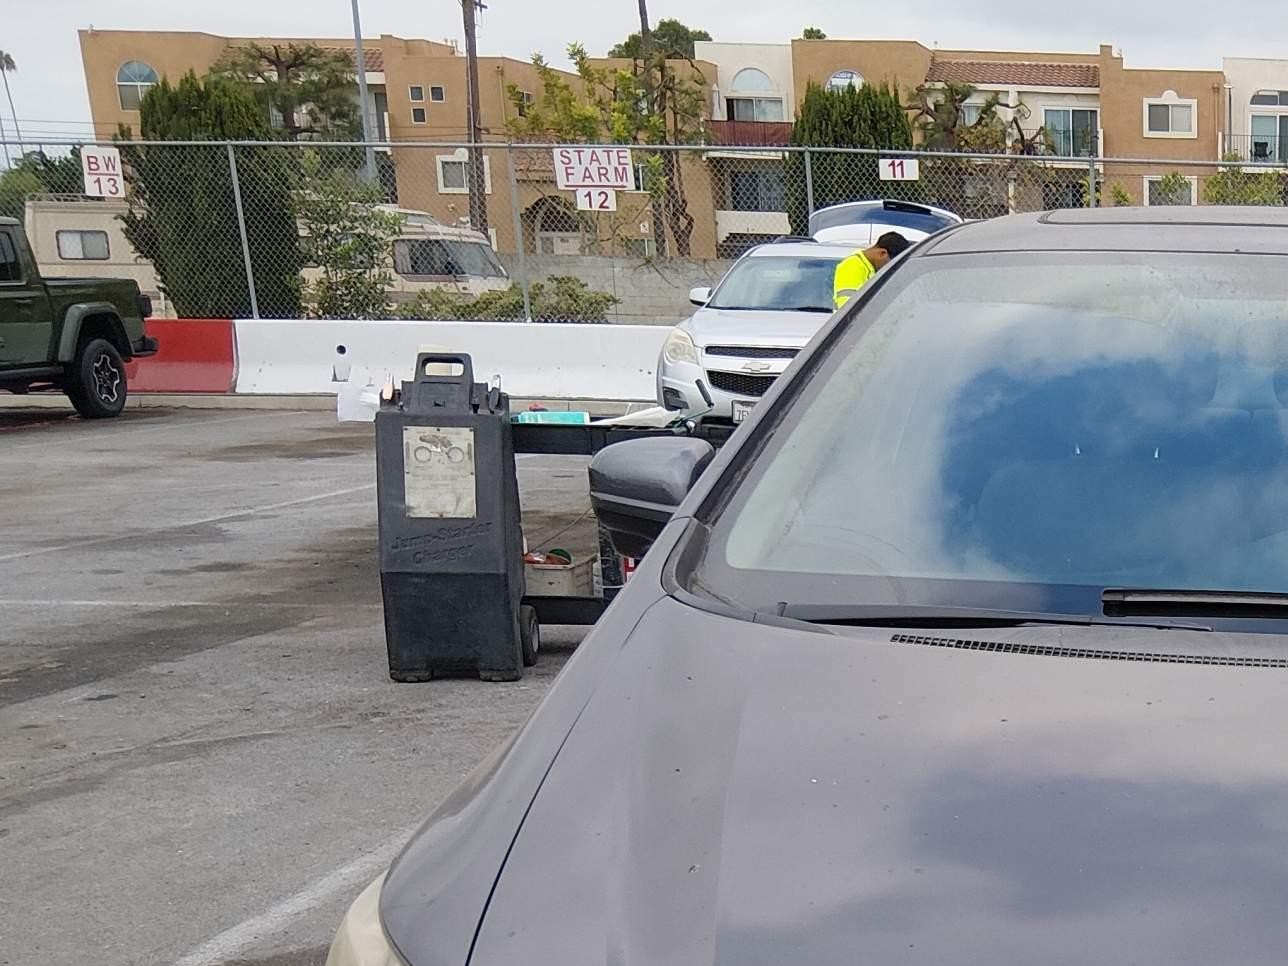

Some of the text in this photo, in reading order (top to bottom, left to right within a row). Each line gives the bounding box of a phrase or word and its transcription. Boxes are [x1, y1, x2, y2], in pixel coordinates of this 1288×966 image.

[86, 155, 116, 172] BW
[559, 149, 629, 166] STATE
[564, 166, 629, 183] FARM
[888, 160, 904, 178] 11
[93, 177, 119, 195] 13
[583, 191, 610, 209] 12
